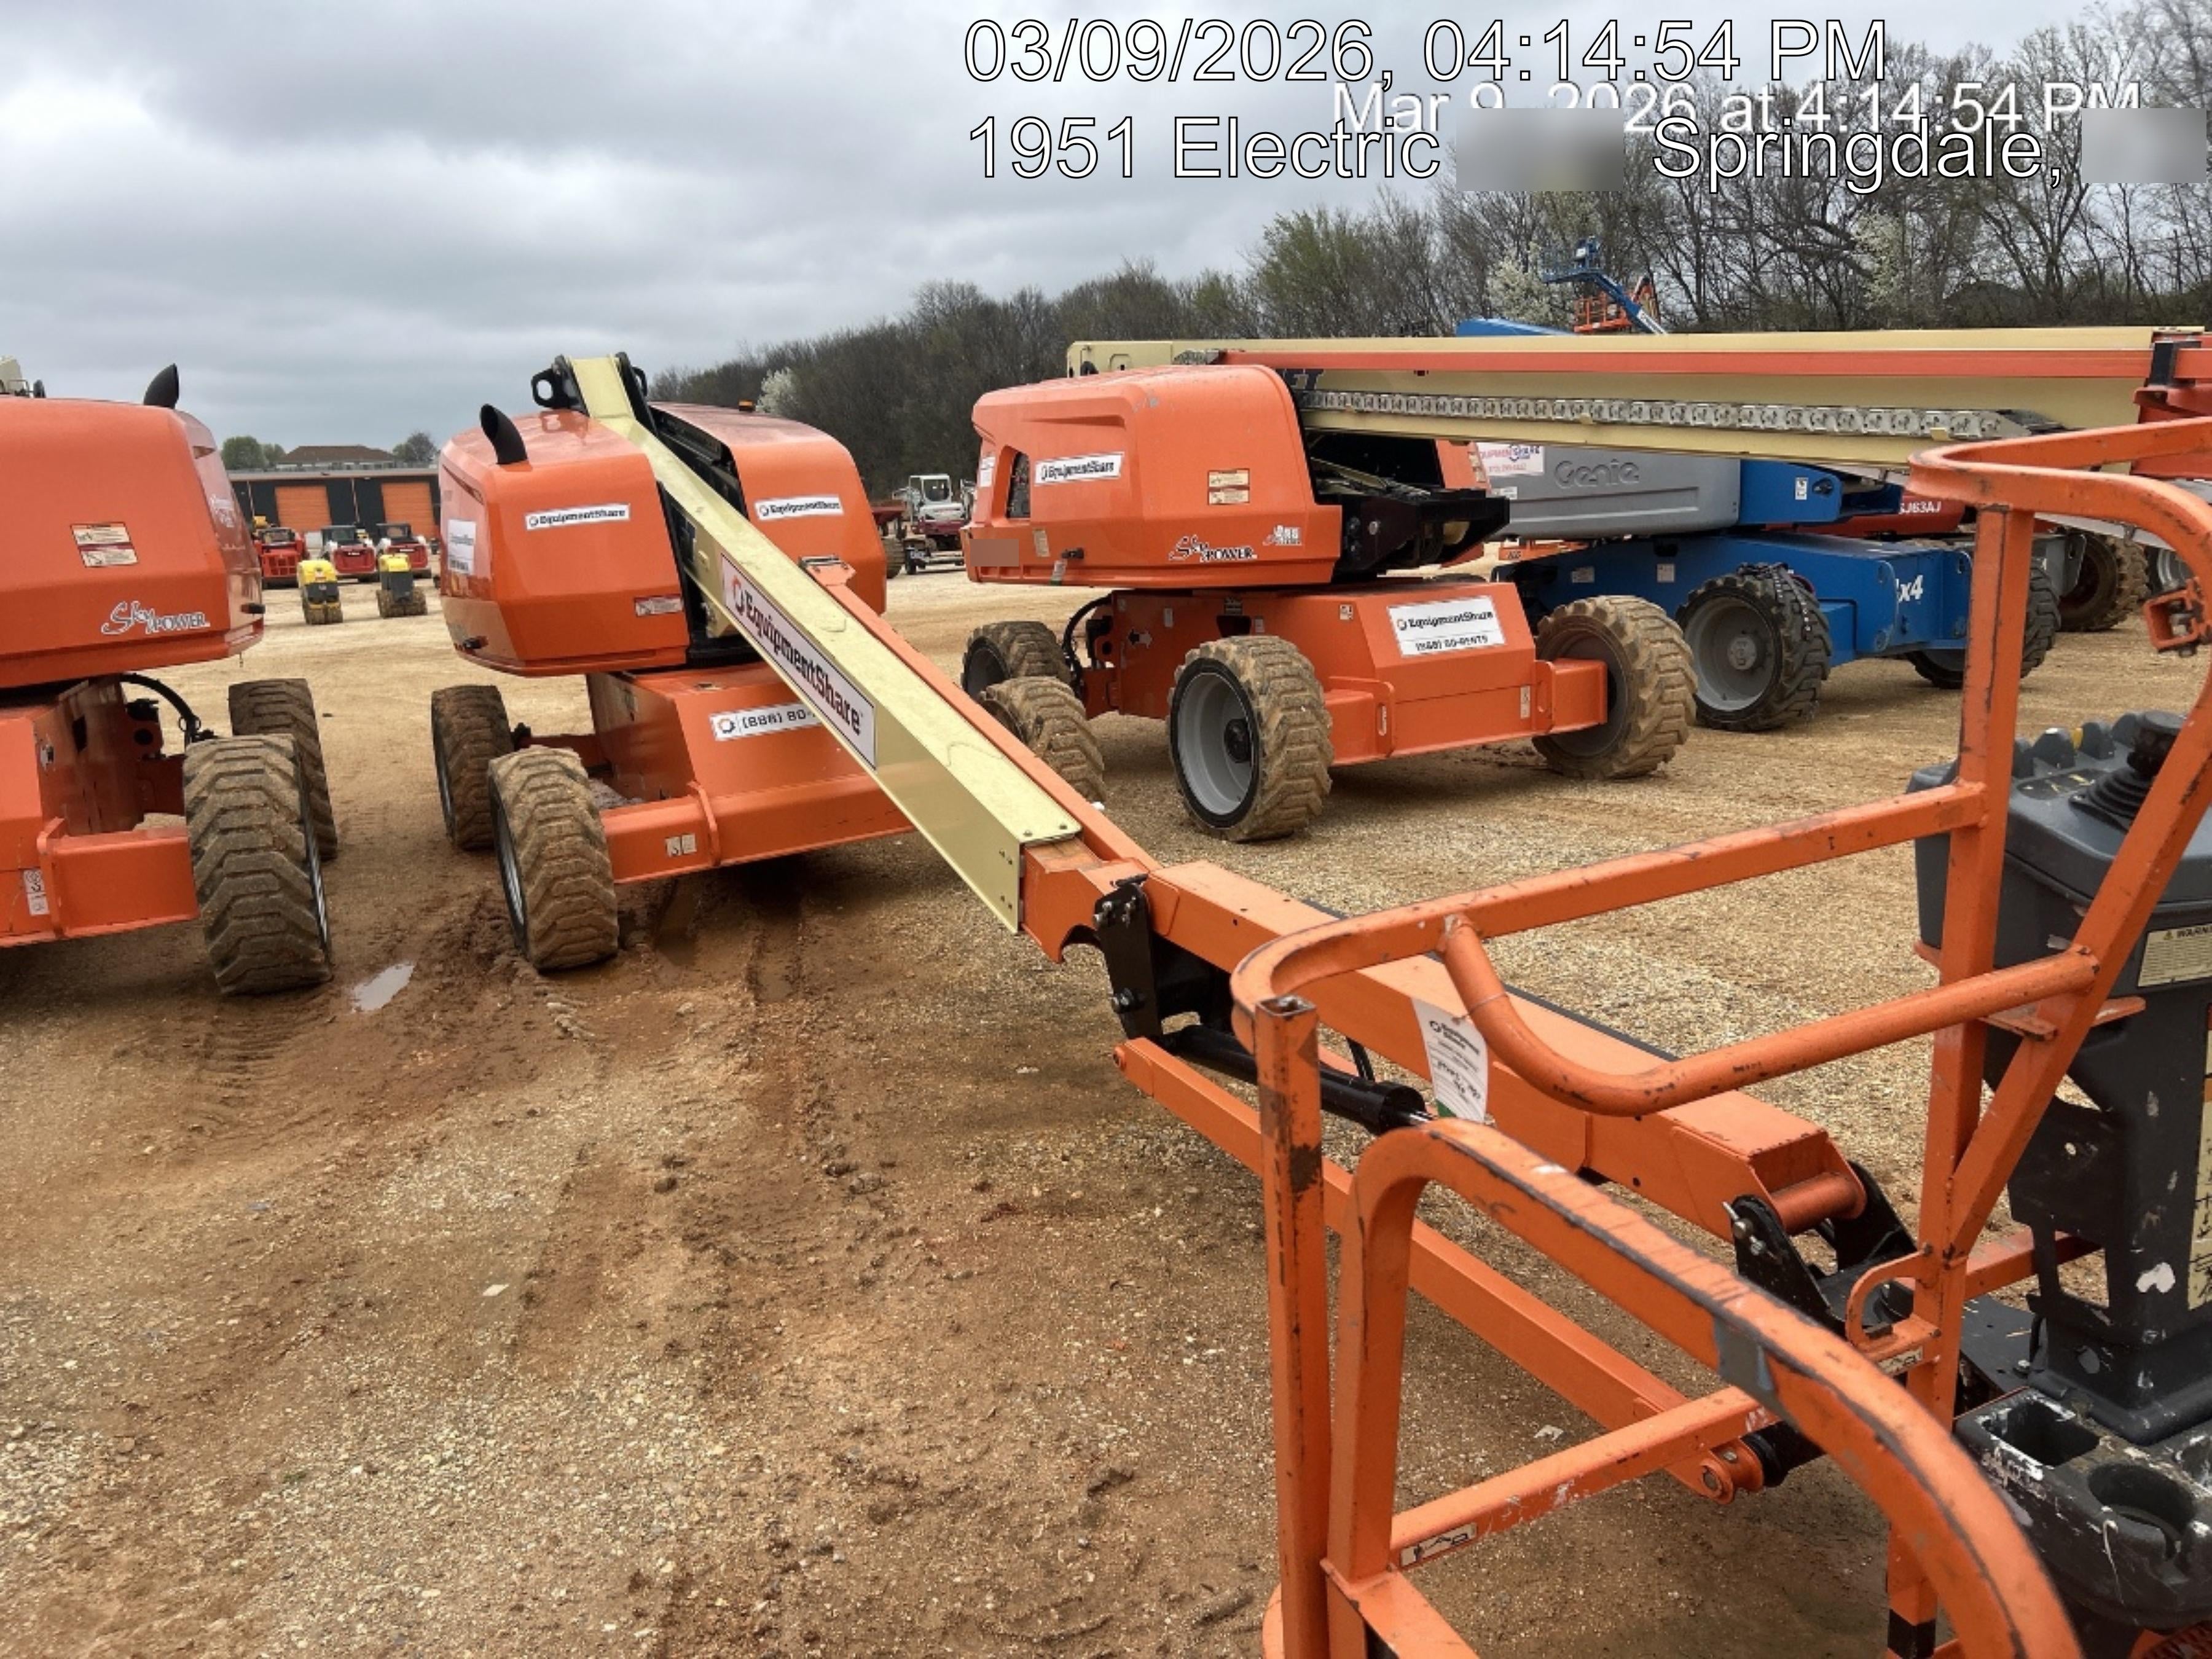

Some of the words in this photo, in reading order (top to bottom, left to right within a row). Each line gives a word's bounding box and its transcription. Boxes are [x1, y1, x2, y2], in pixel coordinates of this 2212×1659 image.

[1555, 458, 1640, 489] Genie
[539, 509, 626, 526] EquipmentShare
[1895, 575, 1924, 603] x4
[743, 589, 862, 736] EquipmentShare
[786, 708, 815, 721] 80-
